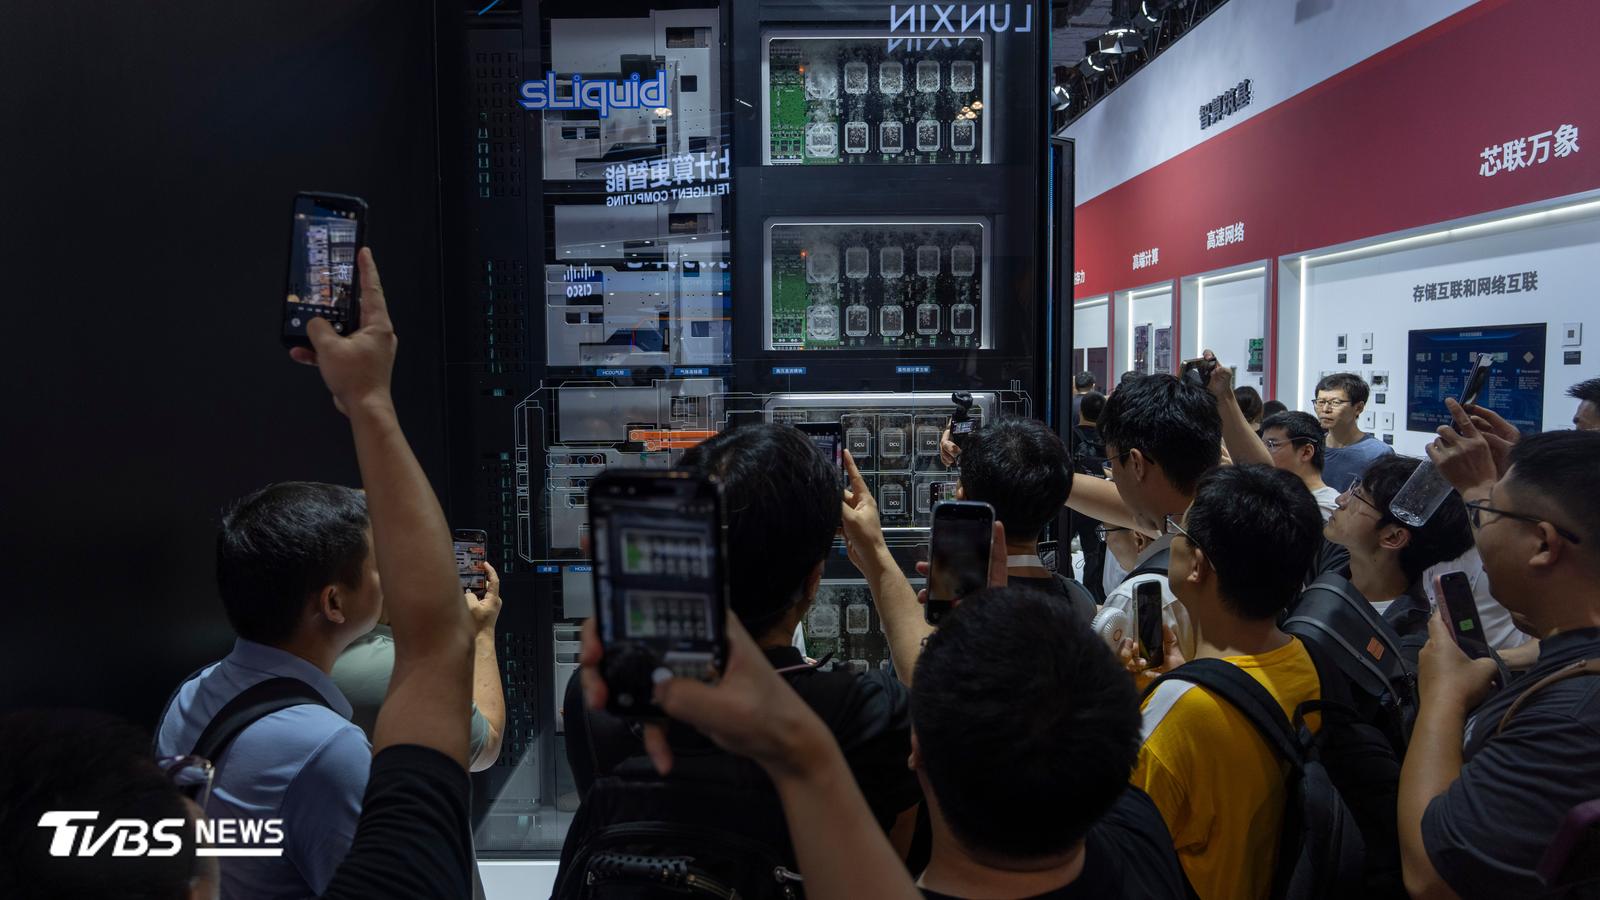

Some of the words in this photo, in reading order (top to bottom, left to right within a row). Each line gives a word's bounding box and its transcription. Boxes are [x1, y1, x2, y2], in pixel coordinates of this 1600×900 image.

[1479, 124, 1580, 177] 芯联万象
[1206, 222, 1245, 250] 高速网络
[1412, 271, 1539, 303] 存储互联和网络互联
